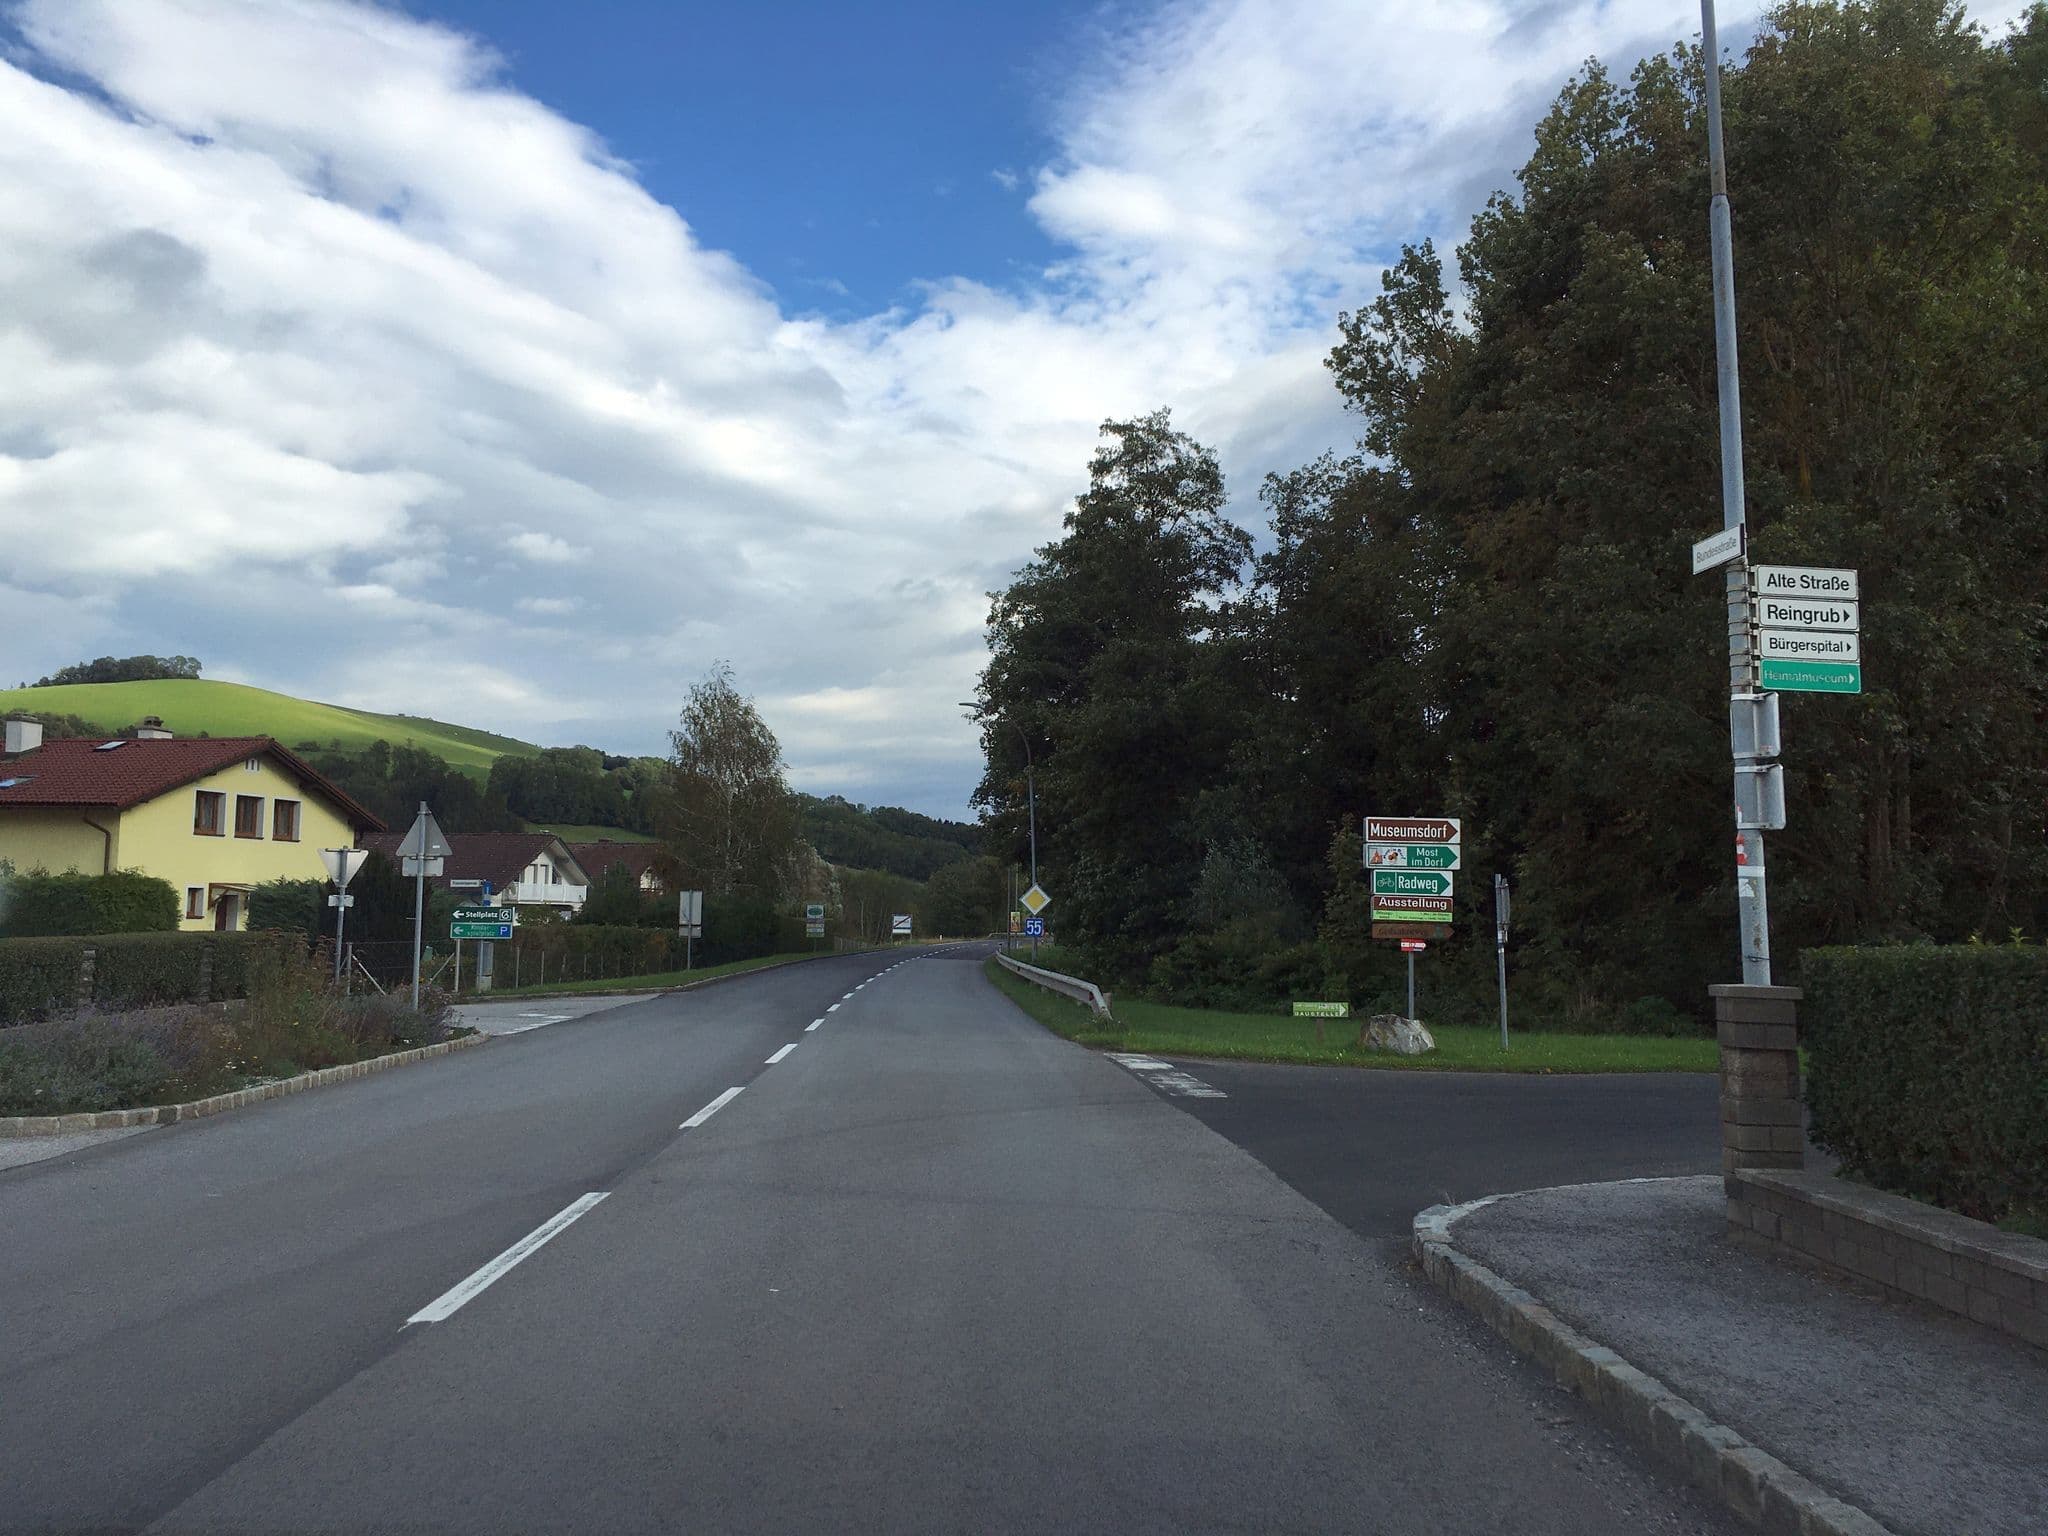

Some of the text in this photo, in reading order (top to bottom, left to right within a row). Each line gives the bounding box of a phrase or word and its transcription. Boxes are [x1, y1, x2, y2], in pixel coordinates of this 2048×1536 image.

[1766, 573, 1850, 591] Alte Straße
[1767, 604, 1840, 625] Reingrub
[1769, 637, 1844, 654] Bürgerspital
[1764, 669, 1848, 684] Heimatmuseum
[1370, 822, 1447, 839] Museumsdorf
[1416, 847, 1439, 857] Most
[1411, 857, 1444, 867] im Dorf
[1398, 875, 1438, 893] Radweg
[1378, 896, 1447, 911] Ausstellung
[465, 911, 498, 919] Stellplatz
[1026, 920, 1042, 935] 55
